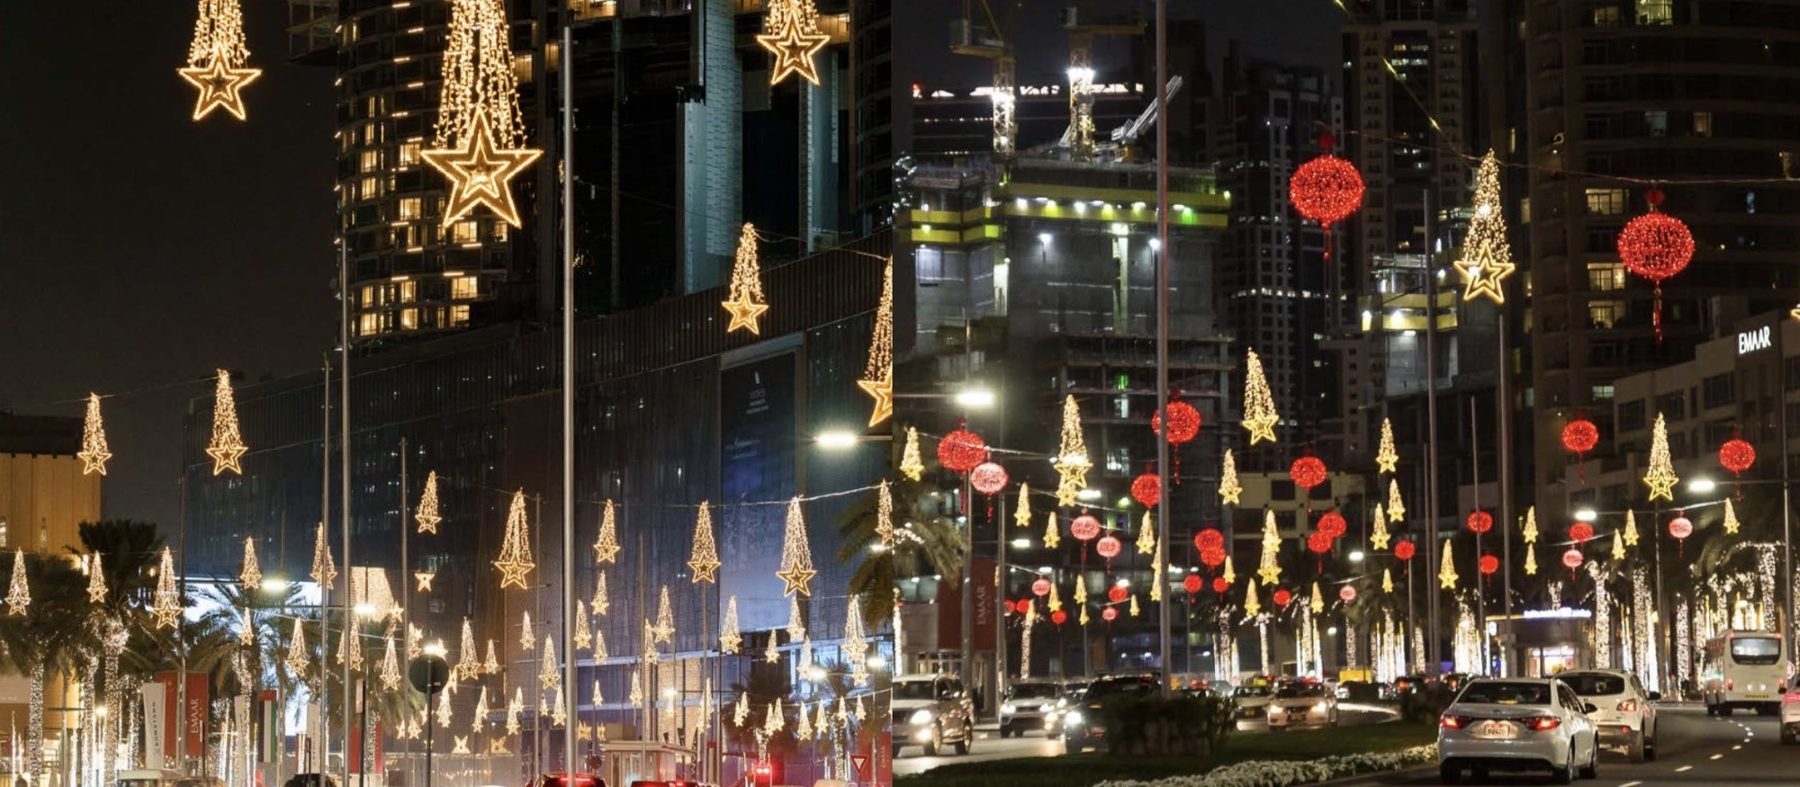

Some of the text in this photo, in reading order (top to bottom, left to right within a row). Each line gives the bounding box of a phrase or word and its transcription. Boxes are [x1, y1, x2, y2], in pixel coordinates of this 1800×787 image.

[1739, 325, 1771, 354] EMAAR
[976, 586, 986, 625] EMAAR
[190, 698, 199, 734] EMAAR
